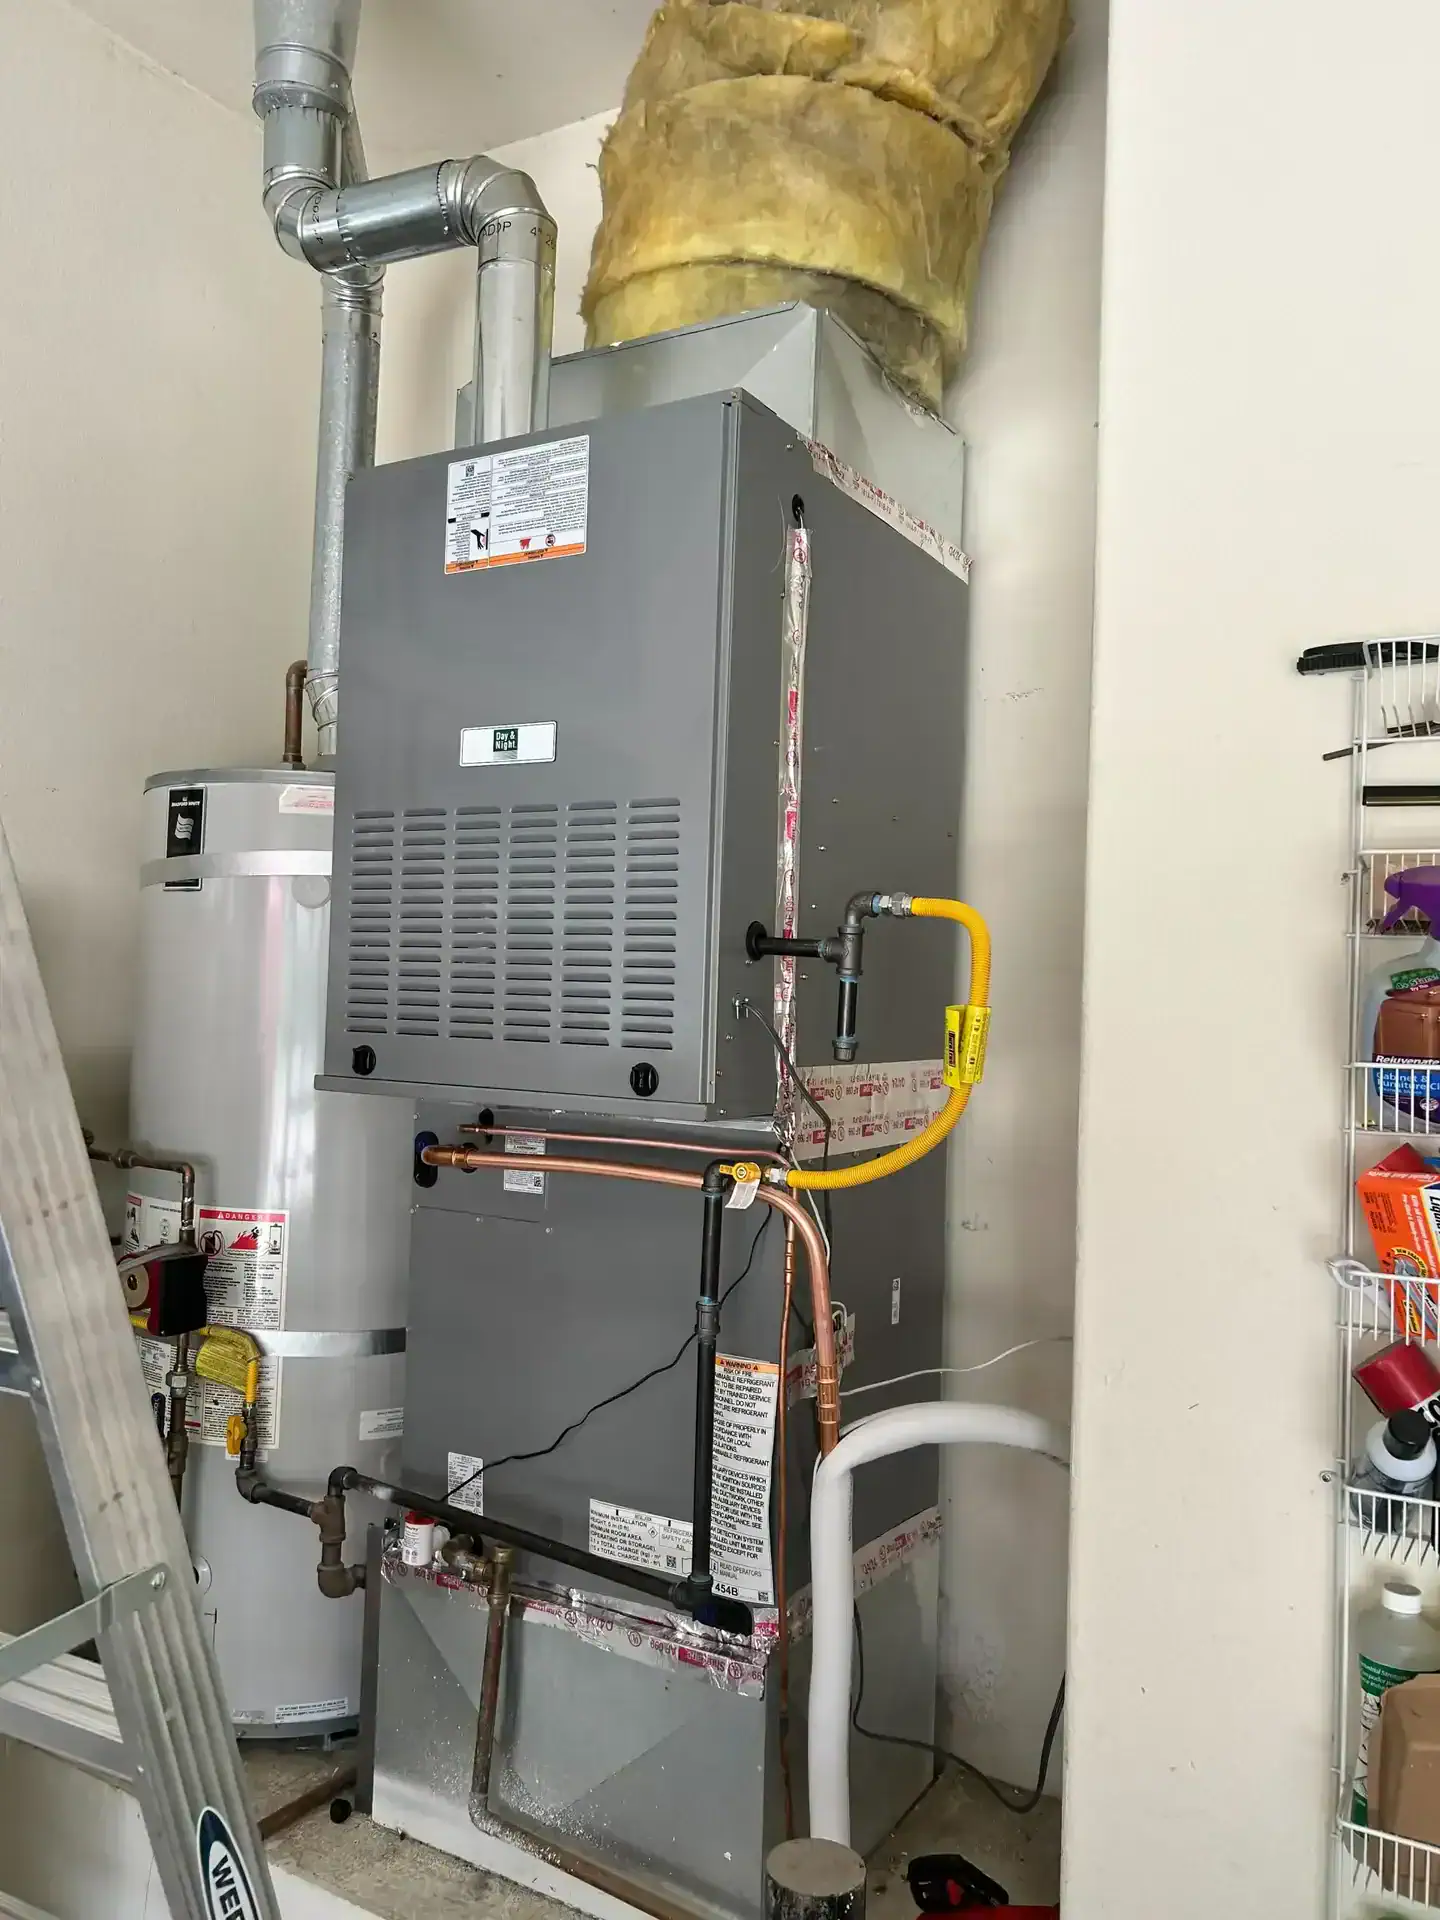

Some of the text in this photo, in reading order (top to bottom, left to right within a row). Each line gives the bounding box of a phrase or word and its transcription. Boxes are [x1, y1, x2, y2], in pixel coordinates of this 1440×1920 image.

[496, 730, 516, 741] Day &
[495, 740, 516, 751] Night
[1376, 1055, 1440, 1065] Rejuvenate
[225, 1212, 265, 1221] DANGER
[725, 1360, 752, 1370] WARNING
[715, 1372, 775, 1388] MMABLE REFRIGERANT
[728, 1382, 735, 1390] BE
[735, 1384, 762, 1394] REPAIRED
[726, 1390, 748, 1400] TRAINED
[748, 1394, 772, 1404] SERVICE
[745, 1401, 757, 1409] NOT
[731, 1407, 768, 1418] REFRIGERANT
[713, 1425, 737, 1437] CORDANCE
[714, 1417, 726, 1426] POSE
[733, 1423, 760, 1434] PROPERLY
[713, 1432, 726, 1442] DERAL
[734, 1439, 752, 1448] LOCAL
[713, 1448, 770, 1466] MMABLE REFRIGERANT
[722, 1475, 741, 1486] IGNITION
[741, 1481, 766, 1492] SOURCES
[728, 1470, 748, 1481] DEVICES
[748, 1475, 767, 1484] WHICH
[729, 1485, 736, 1493] BE
[736, 1487, 763, 1499] INSTALLED
[718, 1496, 740, 1508] AUXILIARY
[740, 1504, 762, 1515] DEVICES
[746, 1499, 765, 1508] OTHER
[711, 1509, 725, 1519] ECIFIC
[751, 1522, 762, 1530] SEE
[720, 1504, 730, 1512] FOR
[740, 1511, 753, 1520] WITH
[753, 1514, 763, 1523] THE
[610, 1515, 648, 1529] INSTALLATION
[711, 1516, 737, 1530] TRUCTIONS.
[610, 1528, 627, 1537] ROOM
[627, 1532, 642, 1542] AREA
[663, 1527, 693, 1538] REFRIGERA
[716, 1528, 742, 1541] DETECTION
[742, 1536, 764, 1546] SYSTEM
[661, 1534, 693, 1546] SAFETY GRO
[728, 1539, 740, 1548] UNIT
[740, 1542, 756, 1552] MUST
[600, 1541, 616, 1550] TOTAL
[616, 1545, 639, 1555] CHARGE
[600, 1548, 616, 1557] TOTAL
[617, 1551, 640, 1561] CHARGE
[727, 1546, 746, 1556] EXCEPT
[746, 1552, 759, 1560] FOR
[719, 1570, 738, 1580] MANUAL
[715, 1583, 739, 1596] 454B
